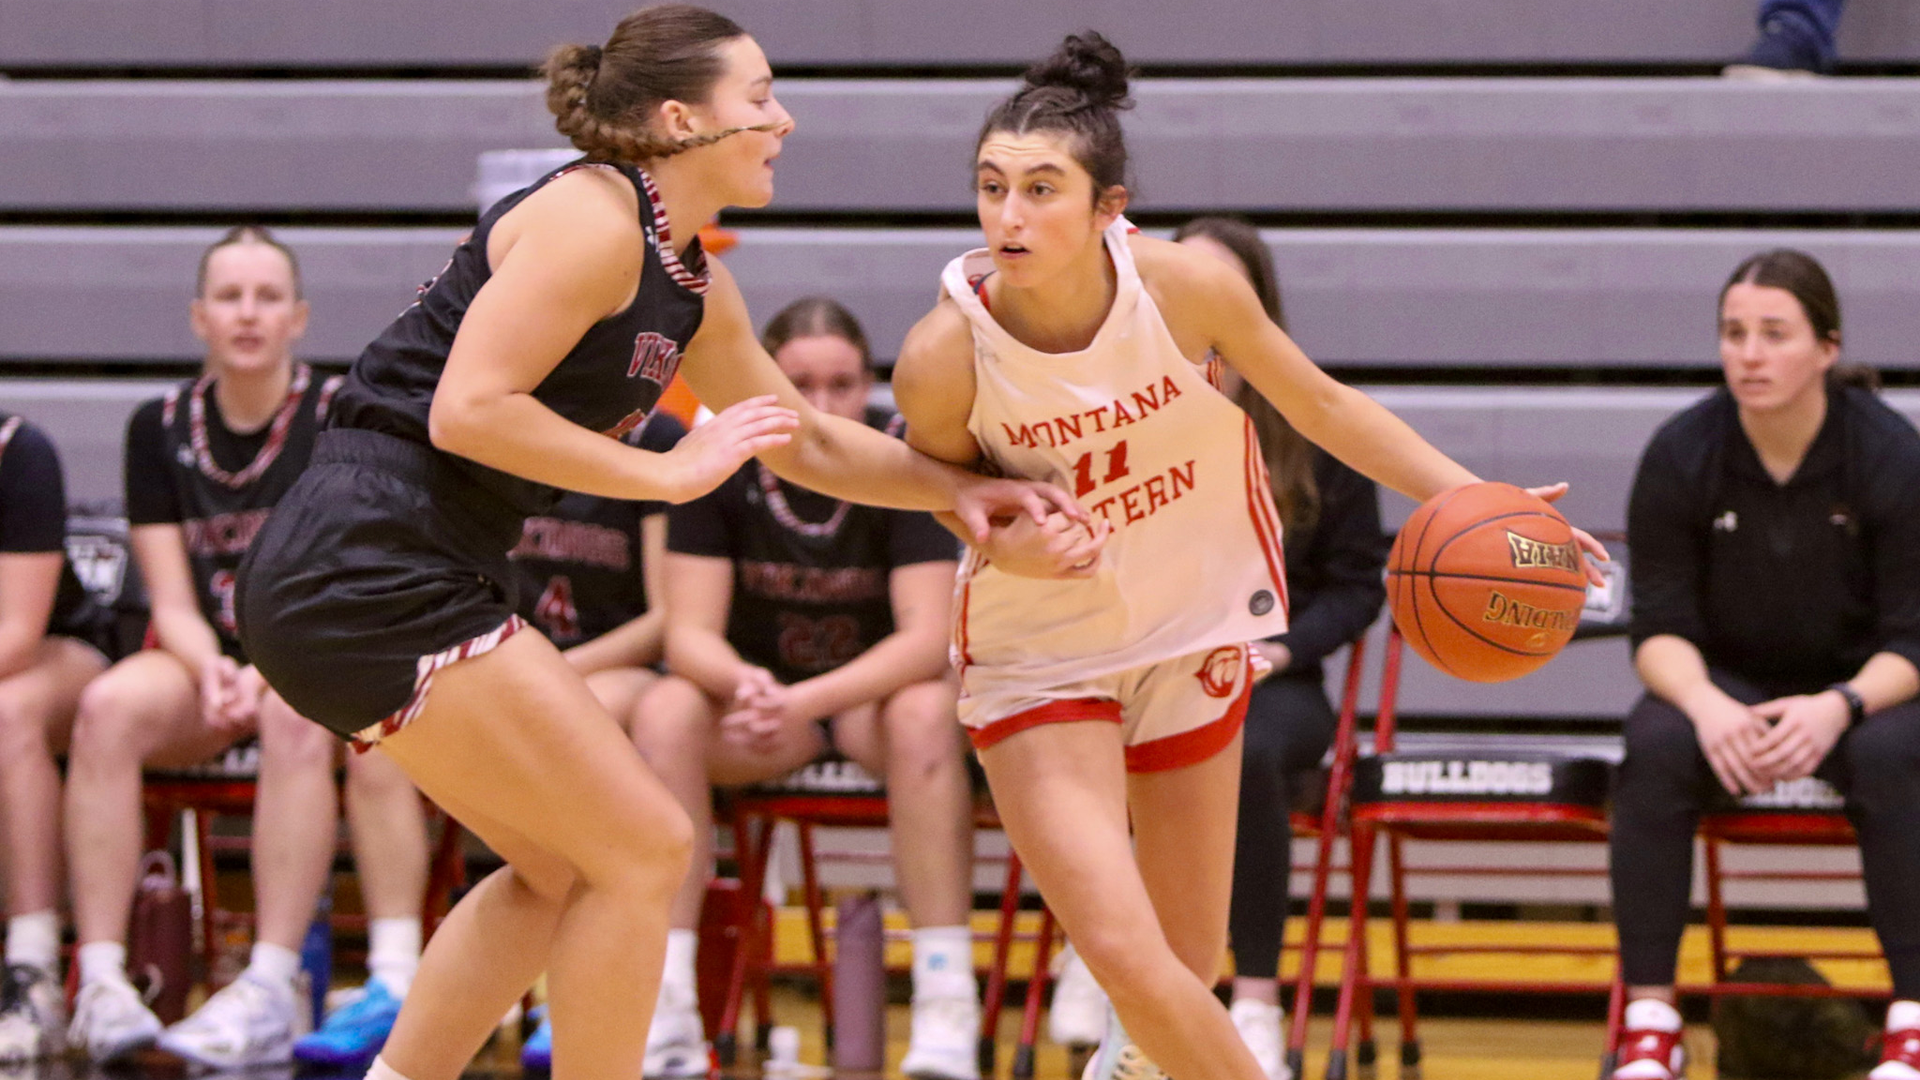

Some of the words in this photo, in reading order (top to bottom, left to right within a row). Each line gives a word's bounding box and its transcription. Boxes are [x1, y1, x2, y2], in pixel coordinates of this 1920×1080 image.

[627, 332, 684, 391] VIK
[1001, 375, 1183, 449] MONTANA
[1072, 439, 1130, 499] 11
[1086, 459, 1196, 539] TERN
